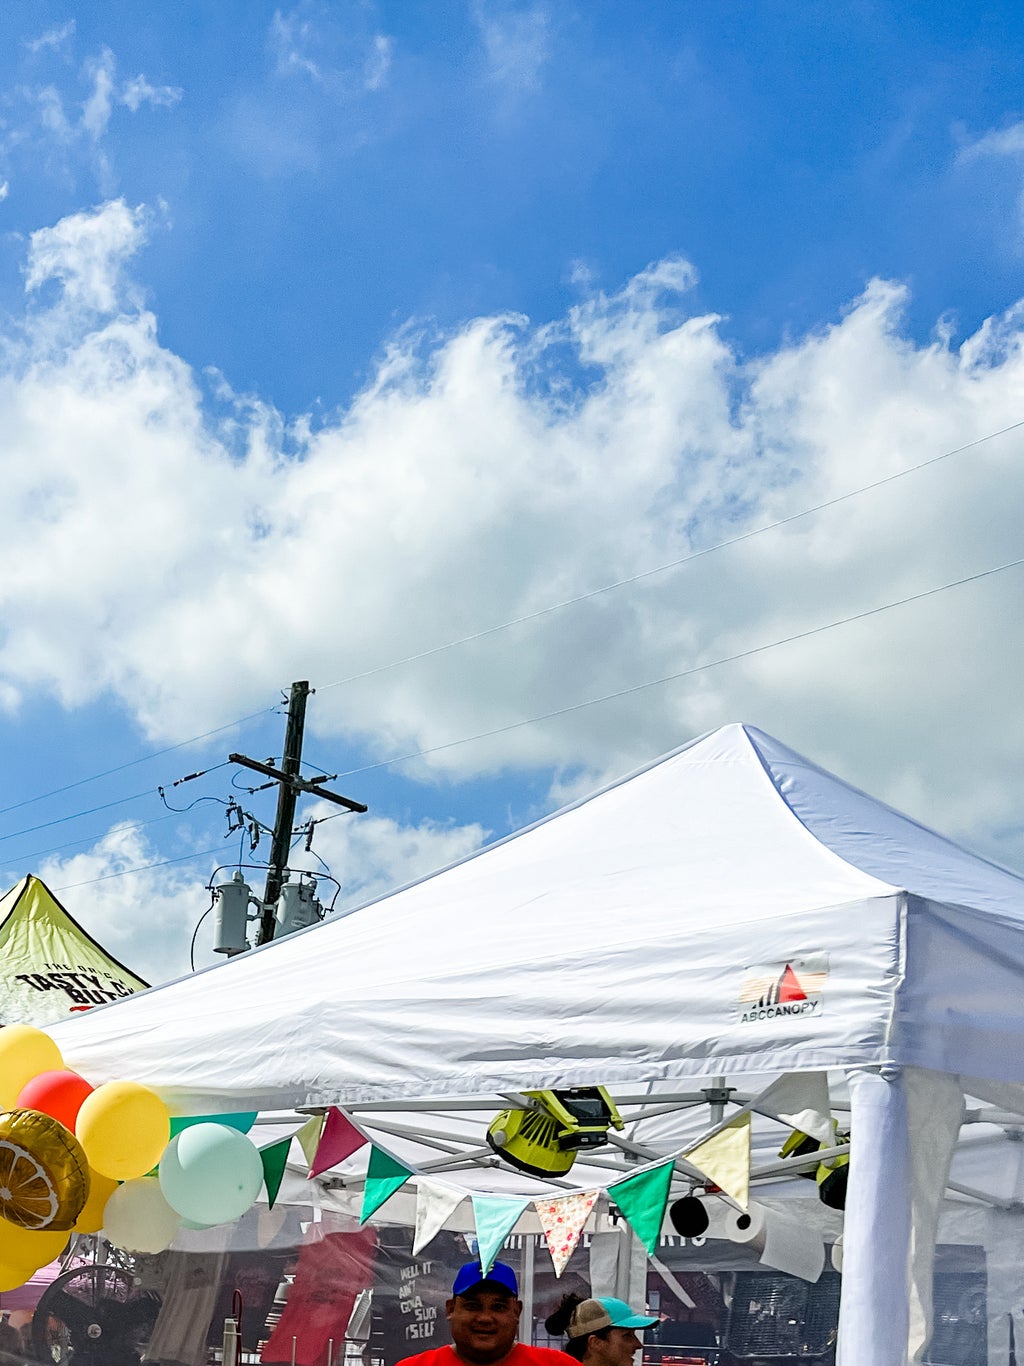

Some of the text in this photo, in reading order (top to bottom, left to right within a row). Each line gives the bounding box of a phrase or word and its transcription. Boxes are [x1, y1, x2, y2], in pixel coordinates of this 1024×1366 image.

[15, 972, 105, 992] TASTY
[741, 1000, 819, 1023] ABCCANOPY
[400, 1261, 432, 1280] WELL IT
